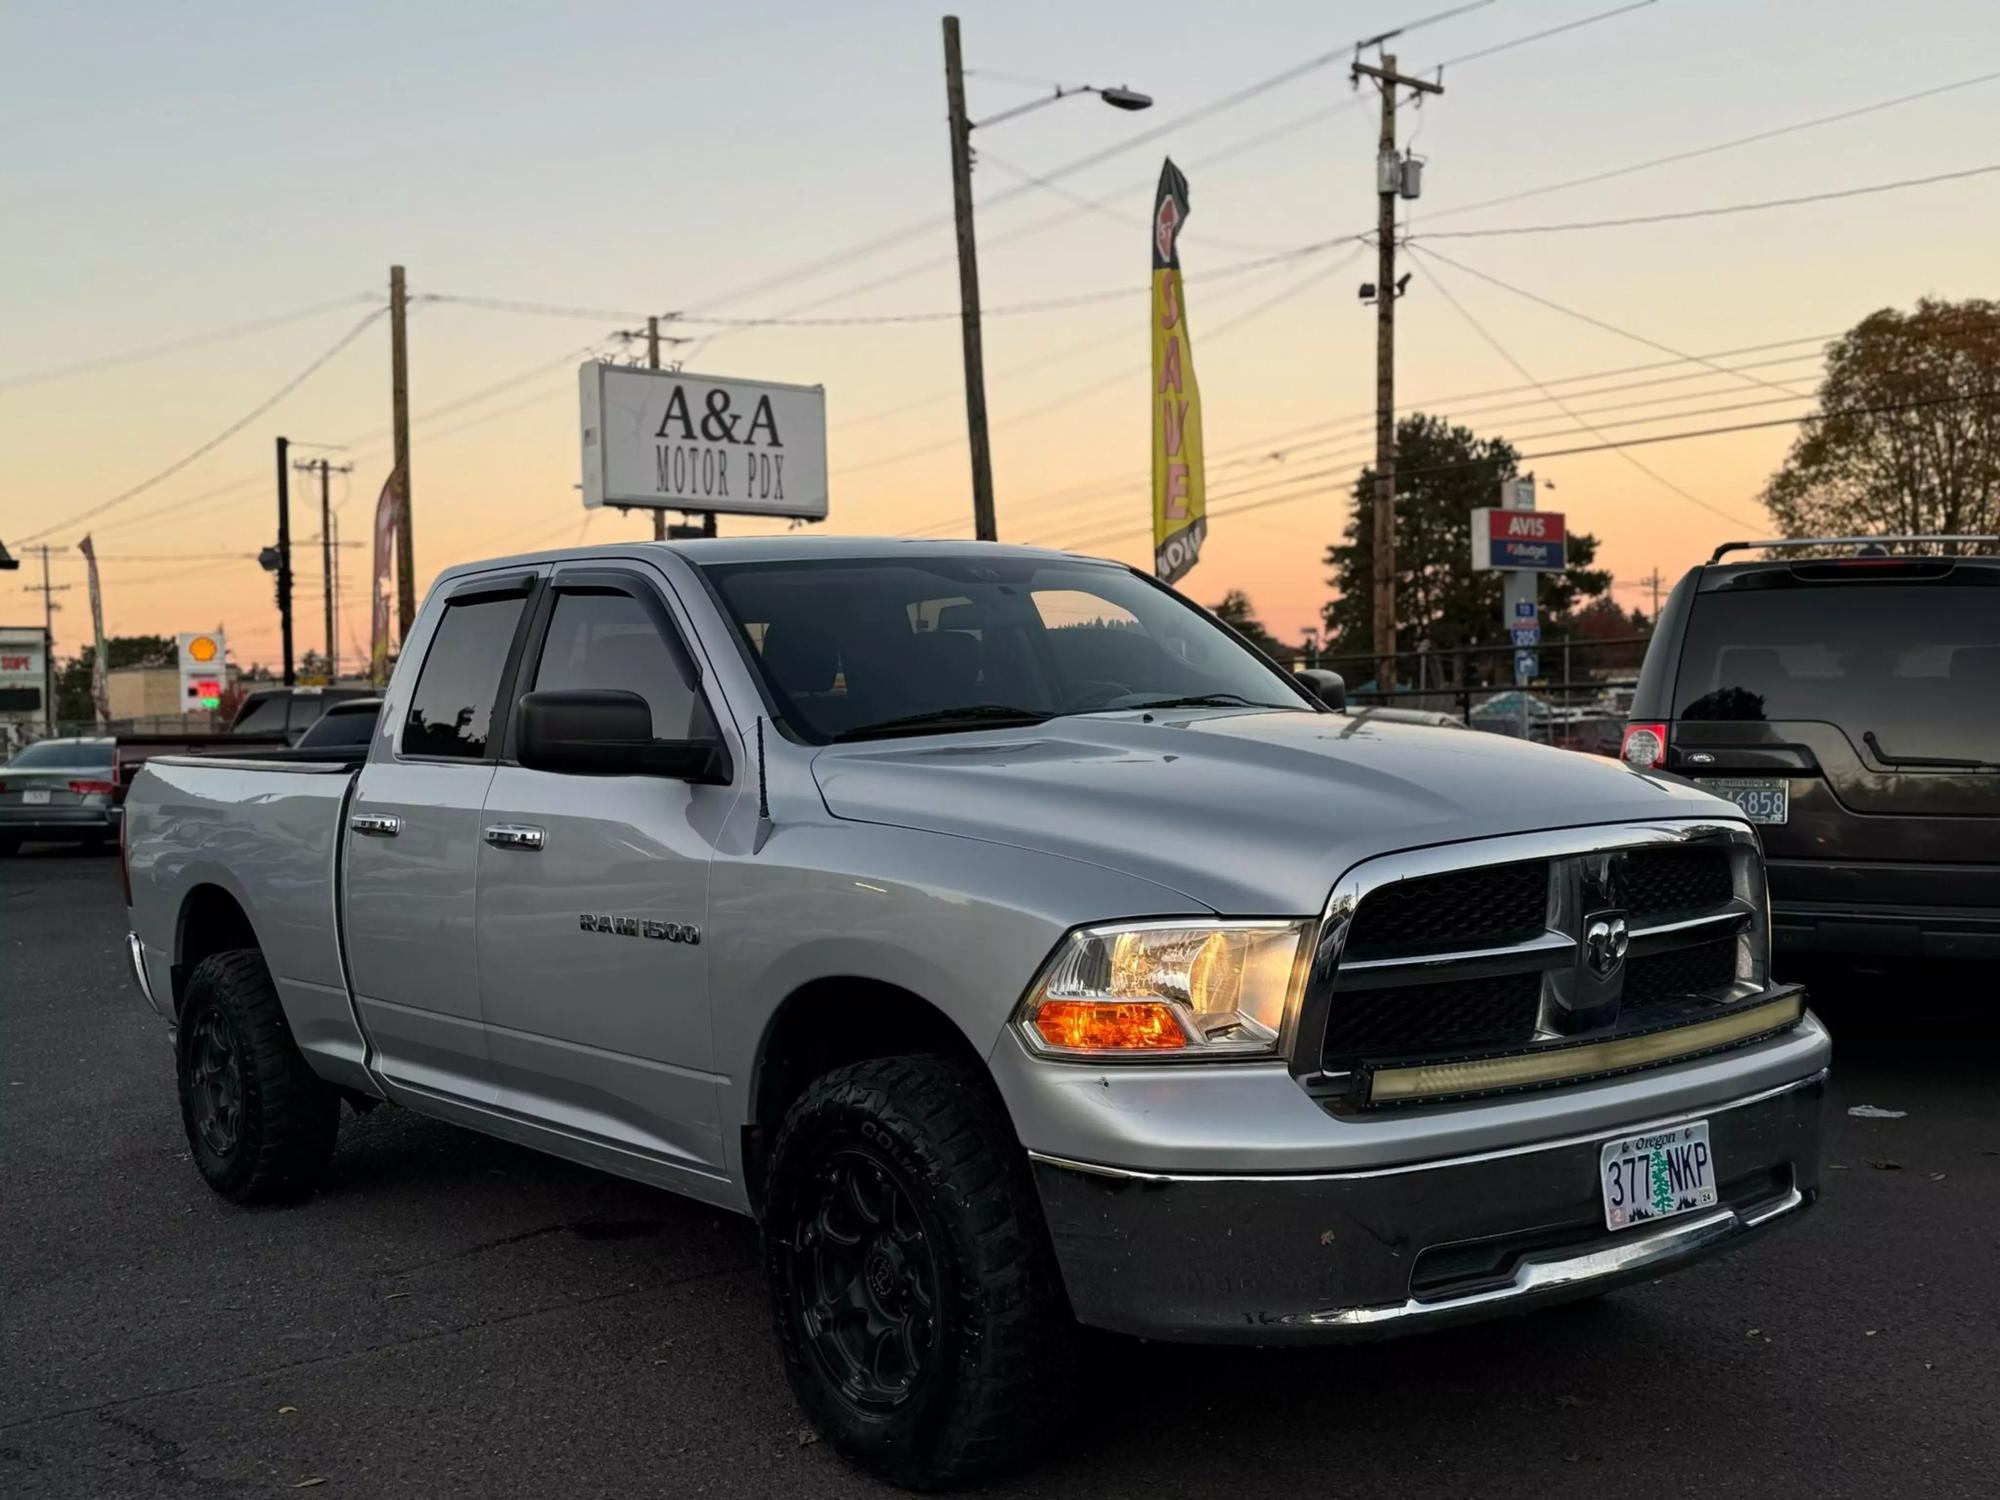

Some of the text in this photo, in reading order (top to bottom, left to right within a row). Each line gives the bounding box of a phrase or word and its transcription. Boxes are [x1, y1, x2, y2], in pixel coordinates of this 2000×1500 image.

[654, 385, 784, 447] A&A
[1158, 271, 1189, 519] SAVE
[656, 445, 784, 500] MOTOR PDX
[1156, 526, 1201, 572] NOW
[1508, 517, 1546, 537] AVIS
[580, 914, 700, 945] RAM 1500
[1635, 1133, 1675, 1149] Oregon
[1608, 1142, 1707, 1206] 377 NKP
